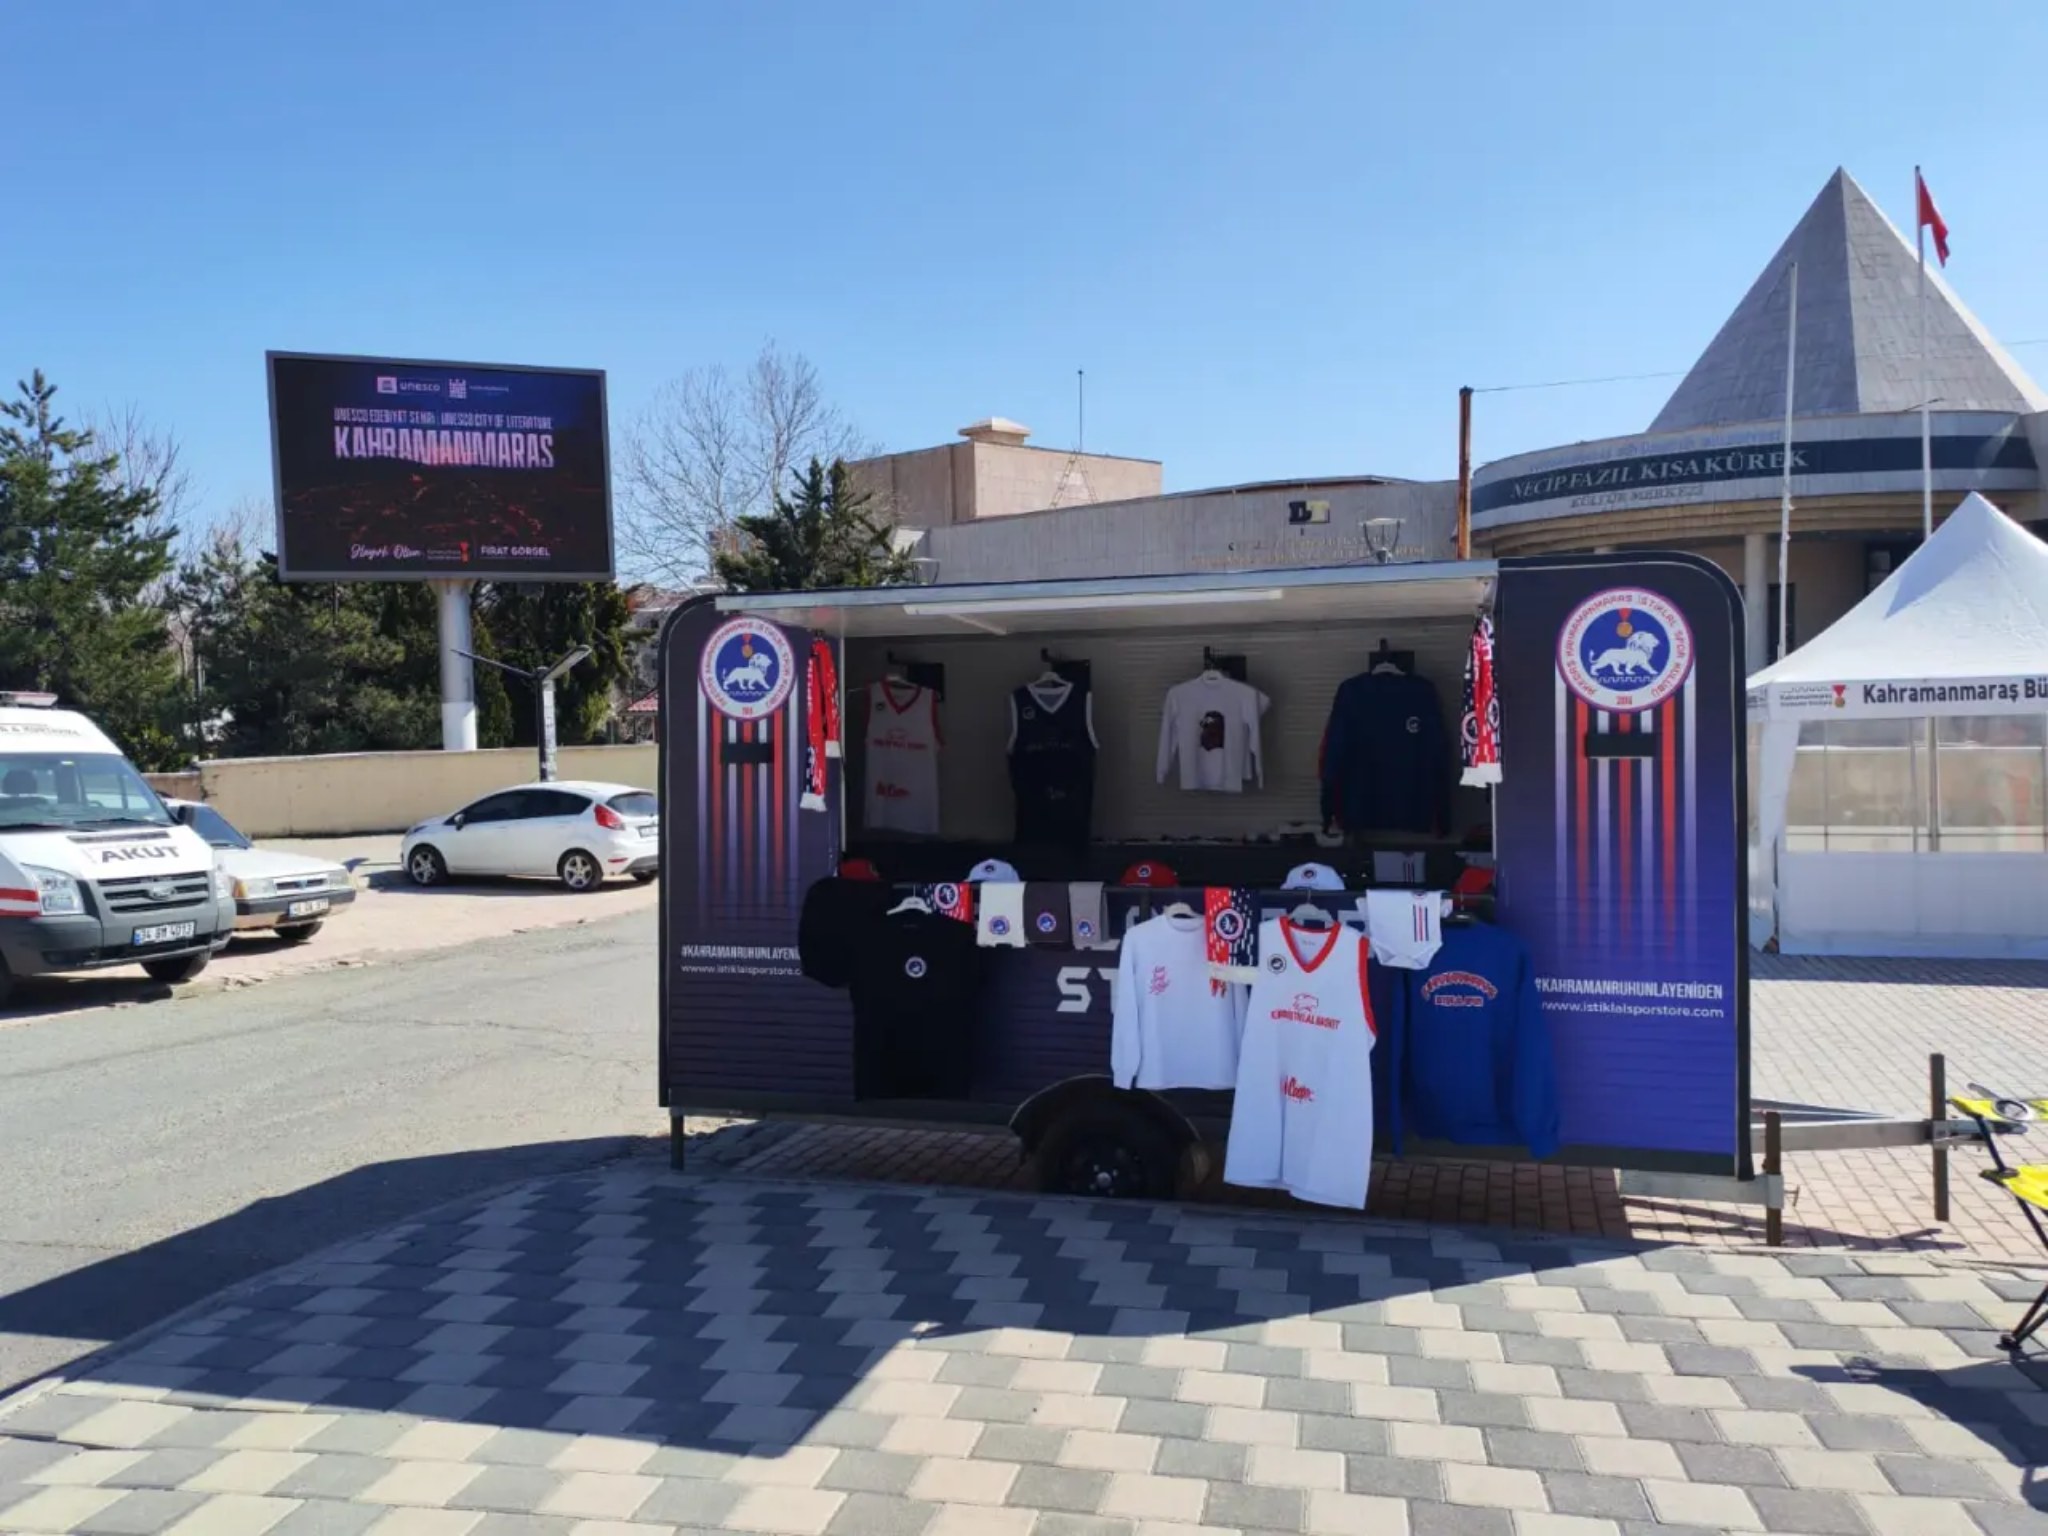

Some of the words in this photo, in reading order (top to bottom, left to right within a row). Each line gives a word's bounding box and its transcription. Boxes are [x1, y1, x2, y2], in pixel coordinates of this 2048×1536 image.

[400, 382, 440, 392] unesco
[1863, 683, 2019, 703] Kahramanmaraş
[102, 845, 180, 863] AKUT
